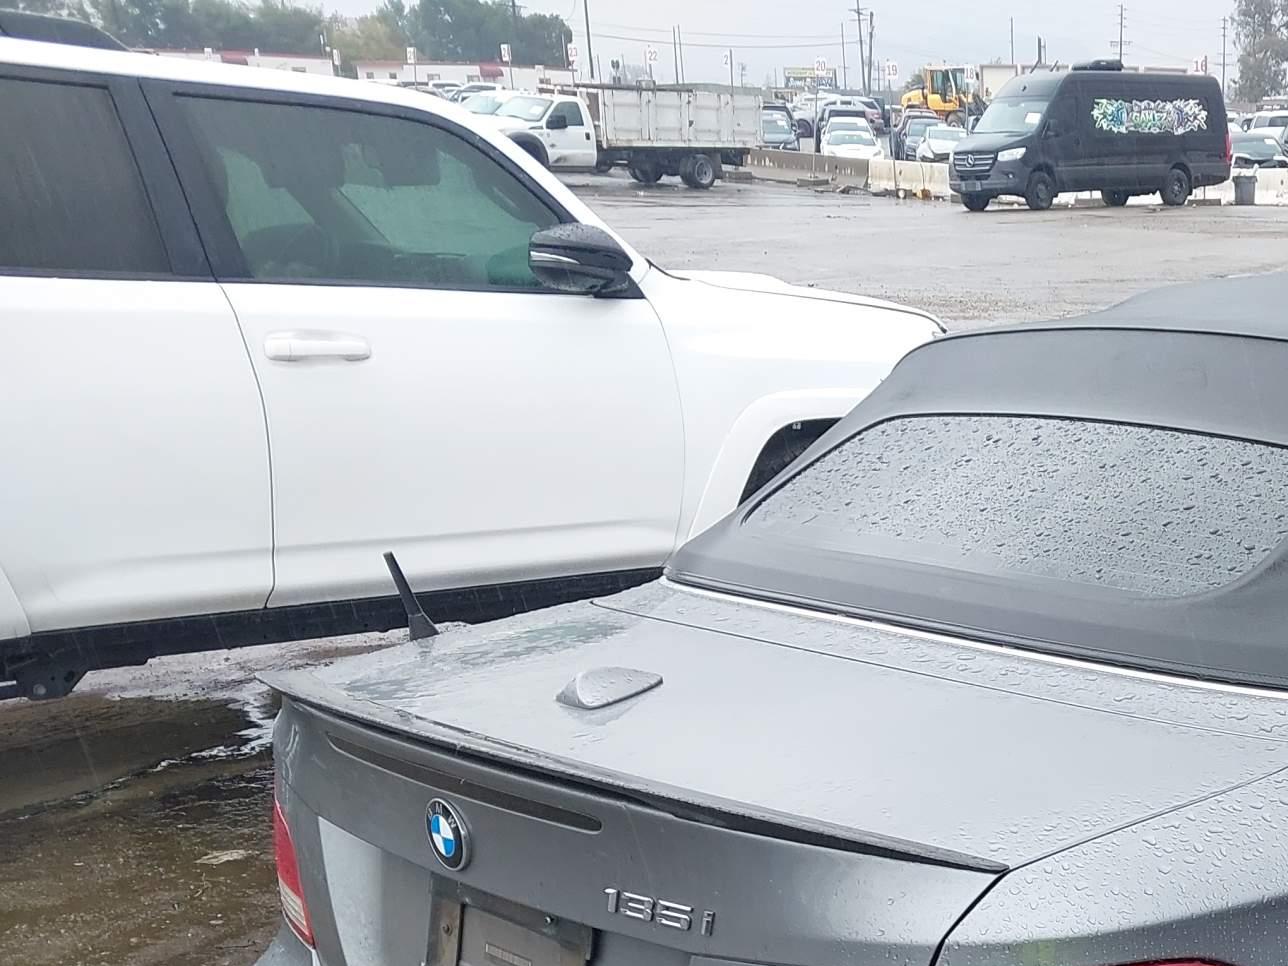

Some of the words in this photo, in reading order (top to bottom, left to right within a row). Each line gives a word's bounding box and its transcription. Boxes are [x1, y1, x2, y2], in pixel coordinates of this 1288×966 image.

[648, 50, 658, 61] 22
[815, 60, 826, 72] 20
[887, 64, 898, 76] 19
[965, 67, 974, 80] 18
